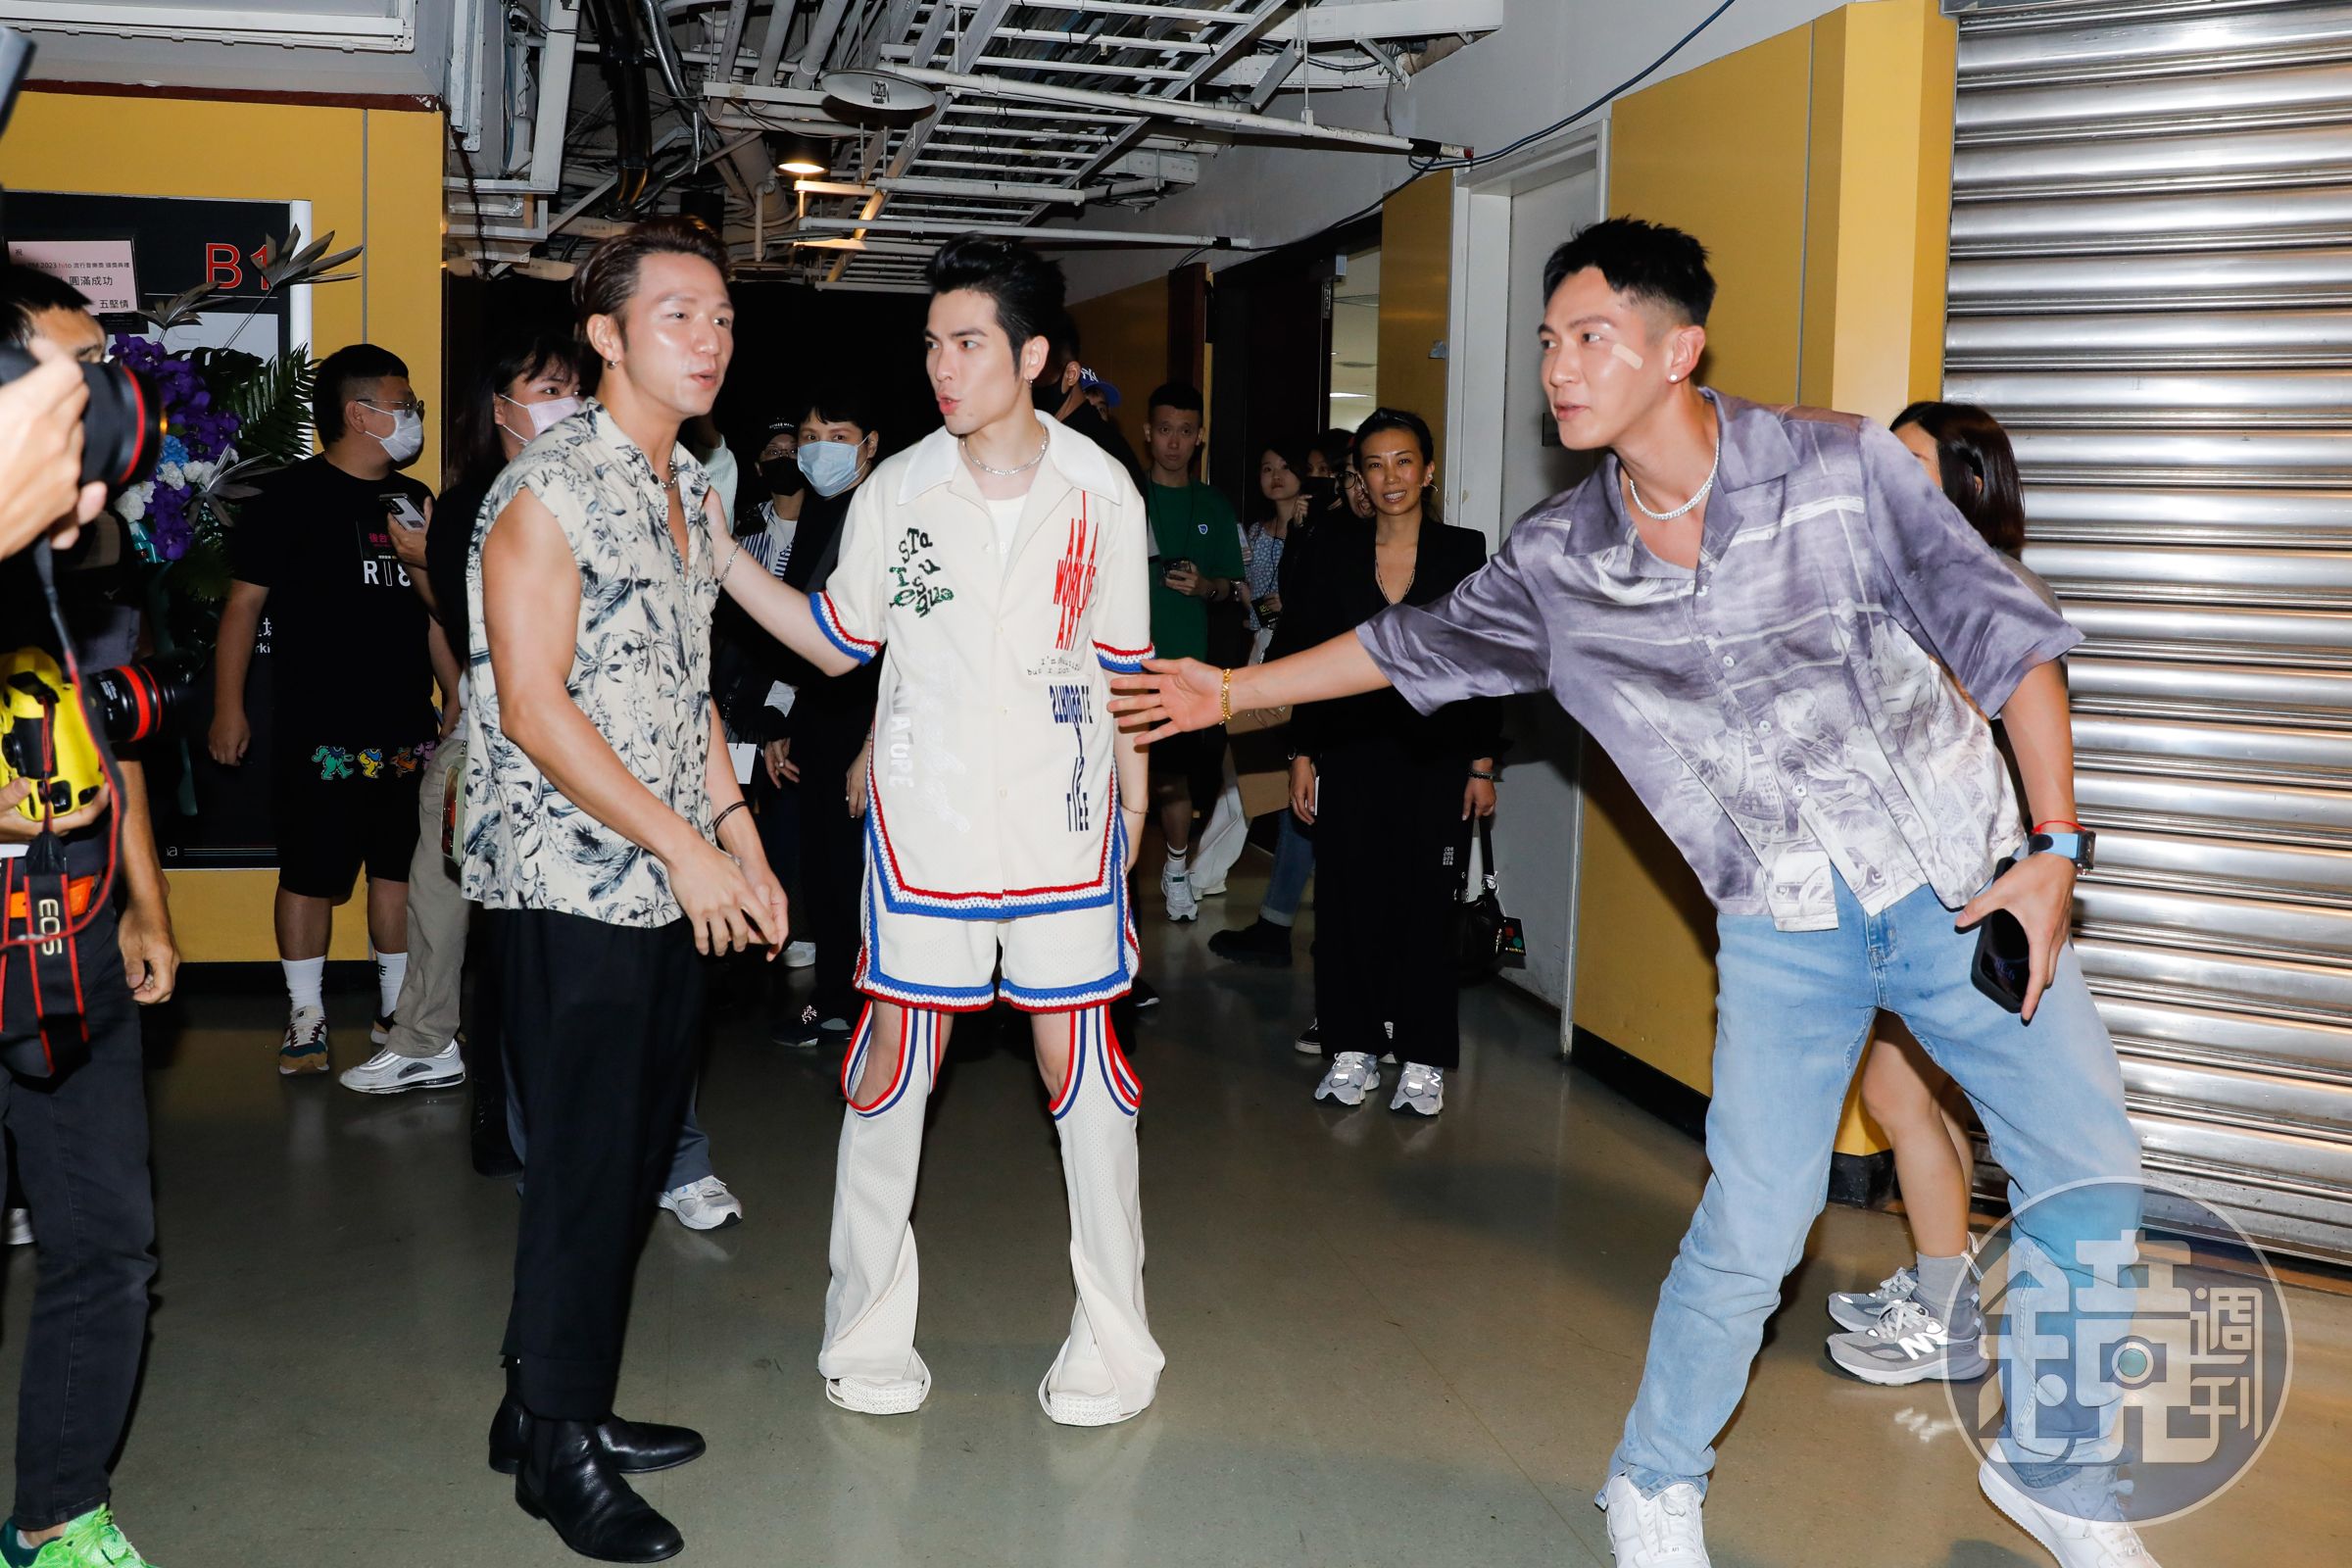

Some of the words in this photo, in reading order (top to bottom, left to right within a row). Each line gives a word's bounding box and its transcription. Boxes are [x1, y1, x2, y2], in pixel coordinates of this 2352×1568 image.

[69, 275, 114, 286] 圓滿成功
[206, 242, 270, 291] B1
[1053, 559, 1085, 609] WORK
[1054, 605, 1082, 652] ART
[38, 898, 63, 956] EOS
